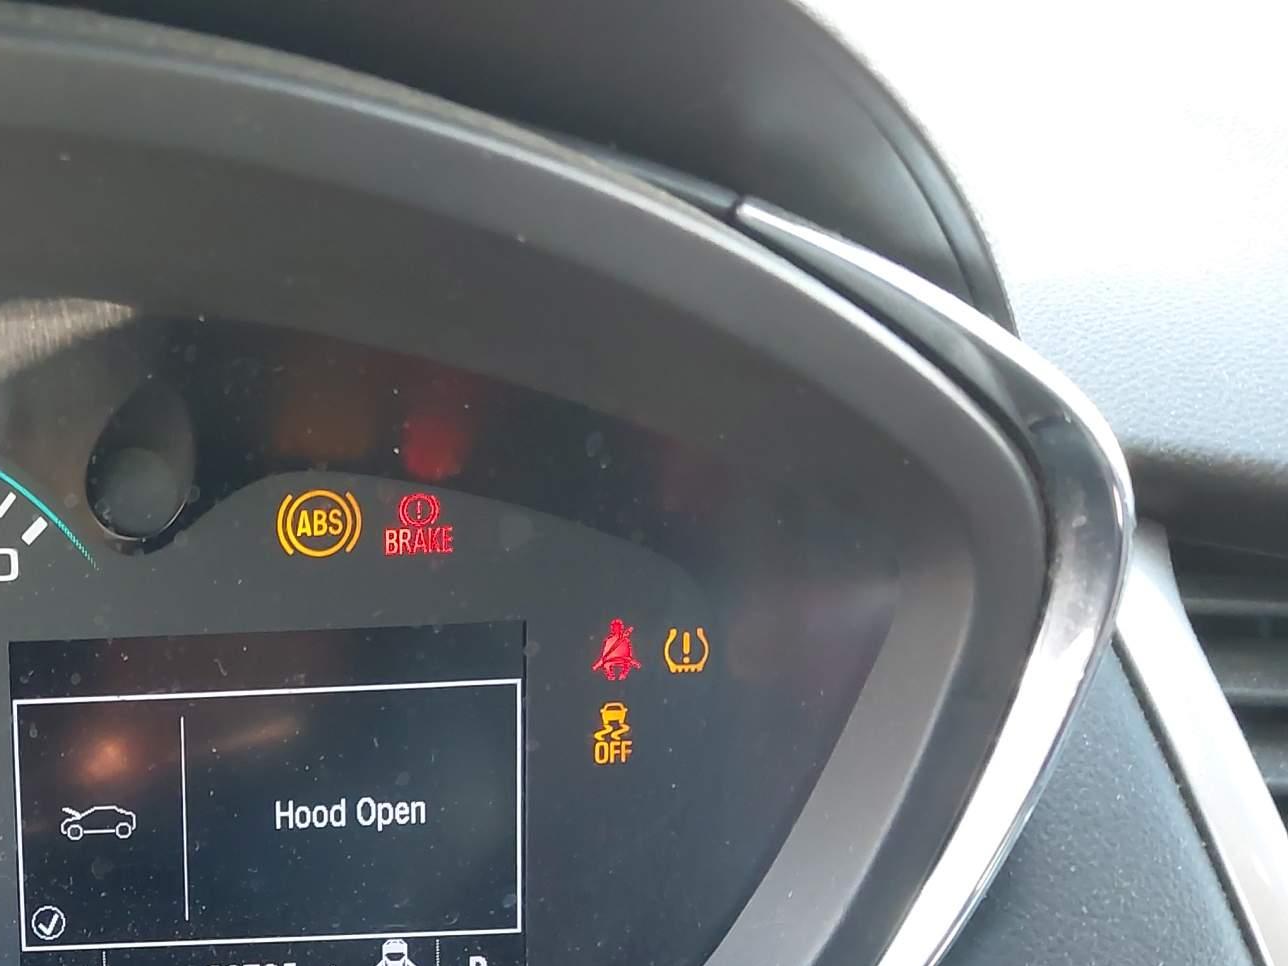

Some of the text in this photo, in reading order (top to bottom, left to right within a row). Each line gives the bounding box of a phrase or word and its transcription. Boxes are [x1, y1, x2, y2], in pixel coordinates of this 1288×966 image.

[296, 509, 343, 537] ABS
[385, 527, 453, 555] BRAKE
[594, 741, 633, 764] OFF
[275, 796, 426, 832] Hood Open
